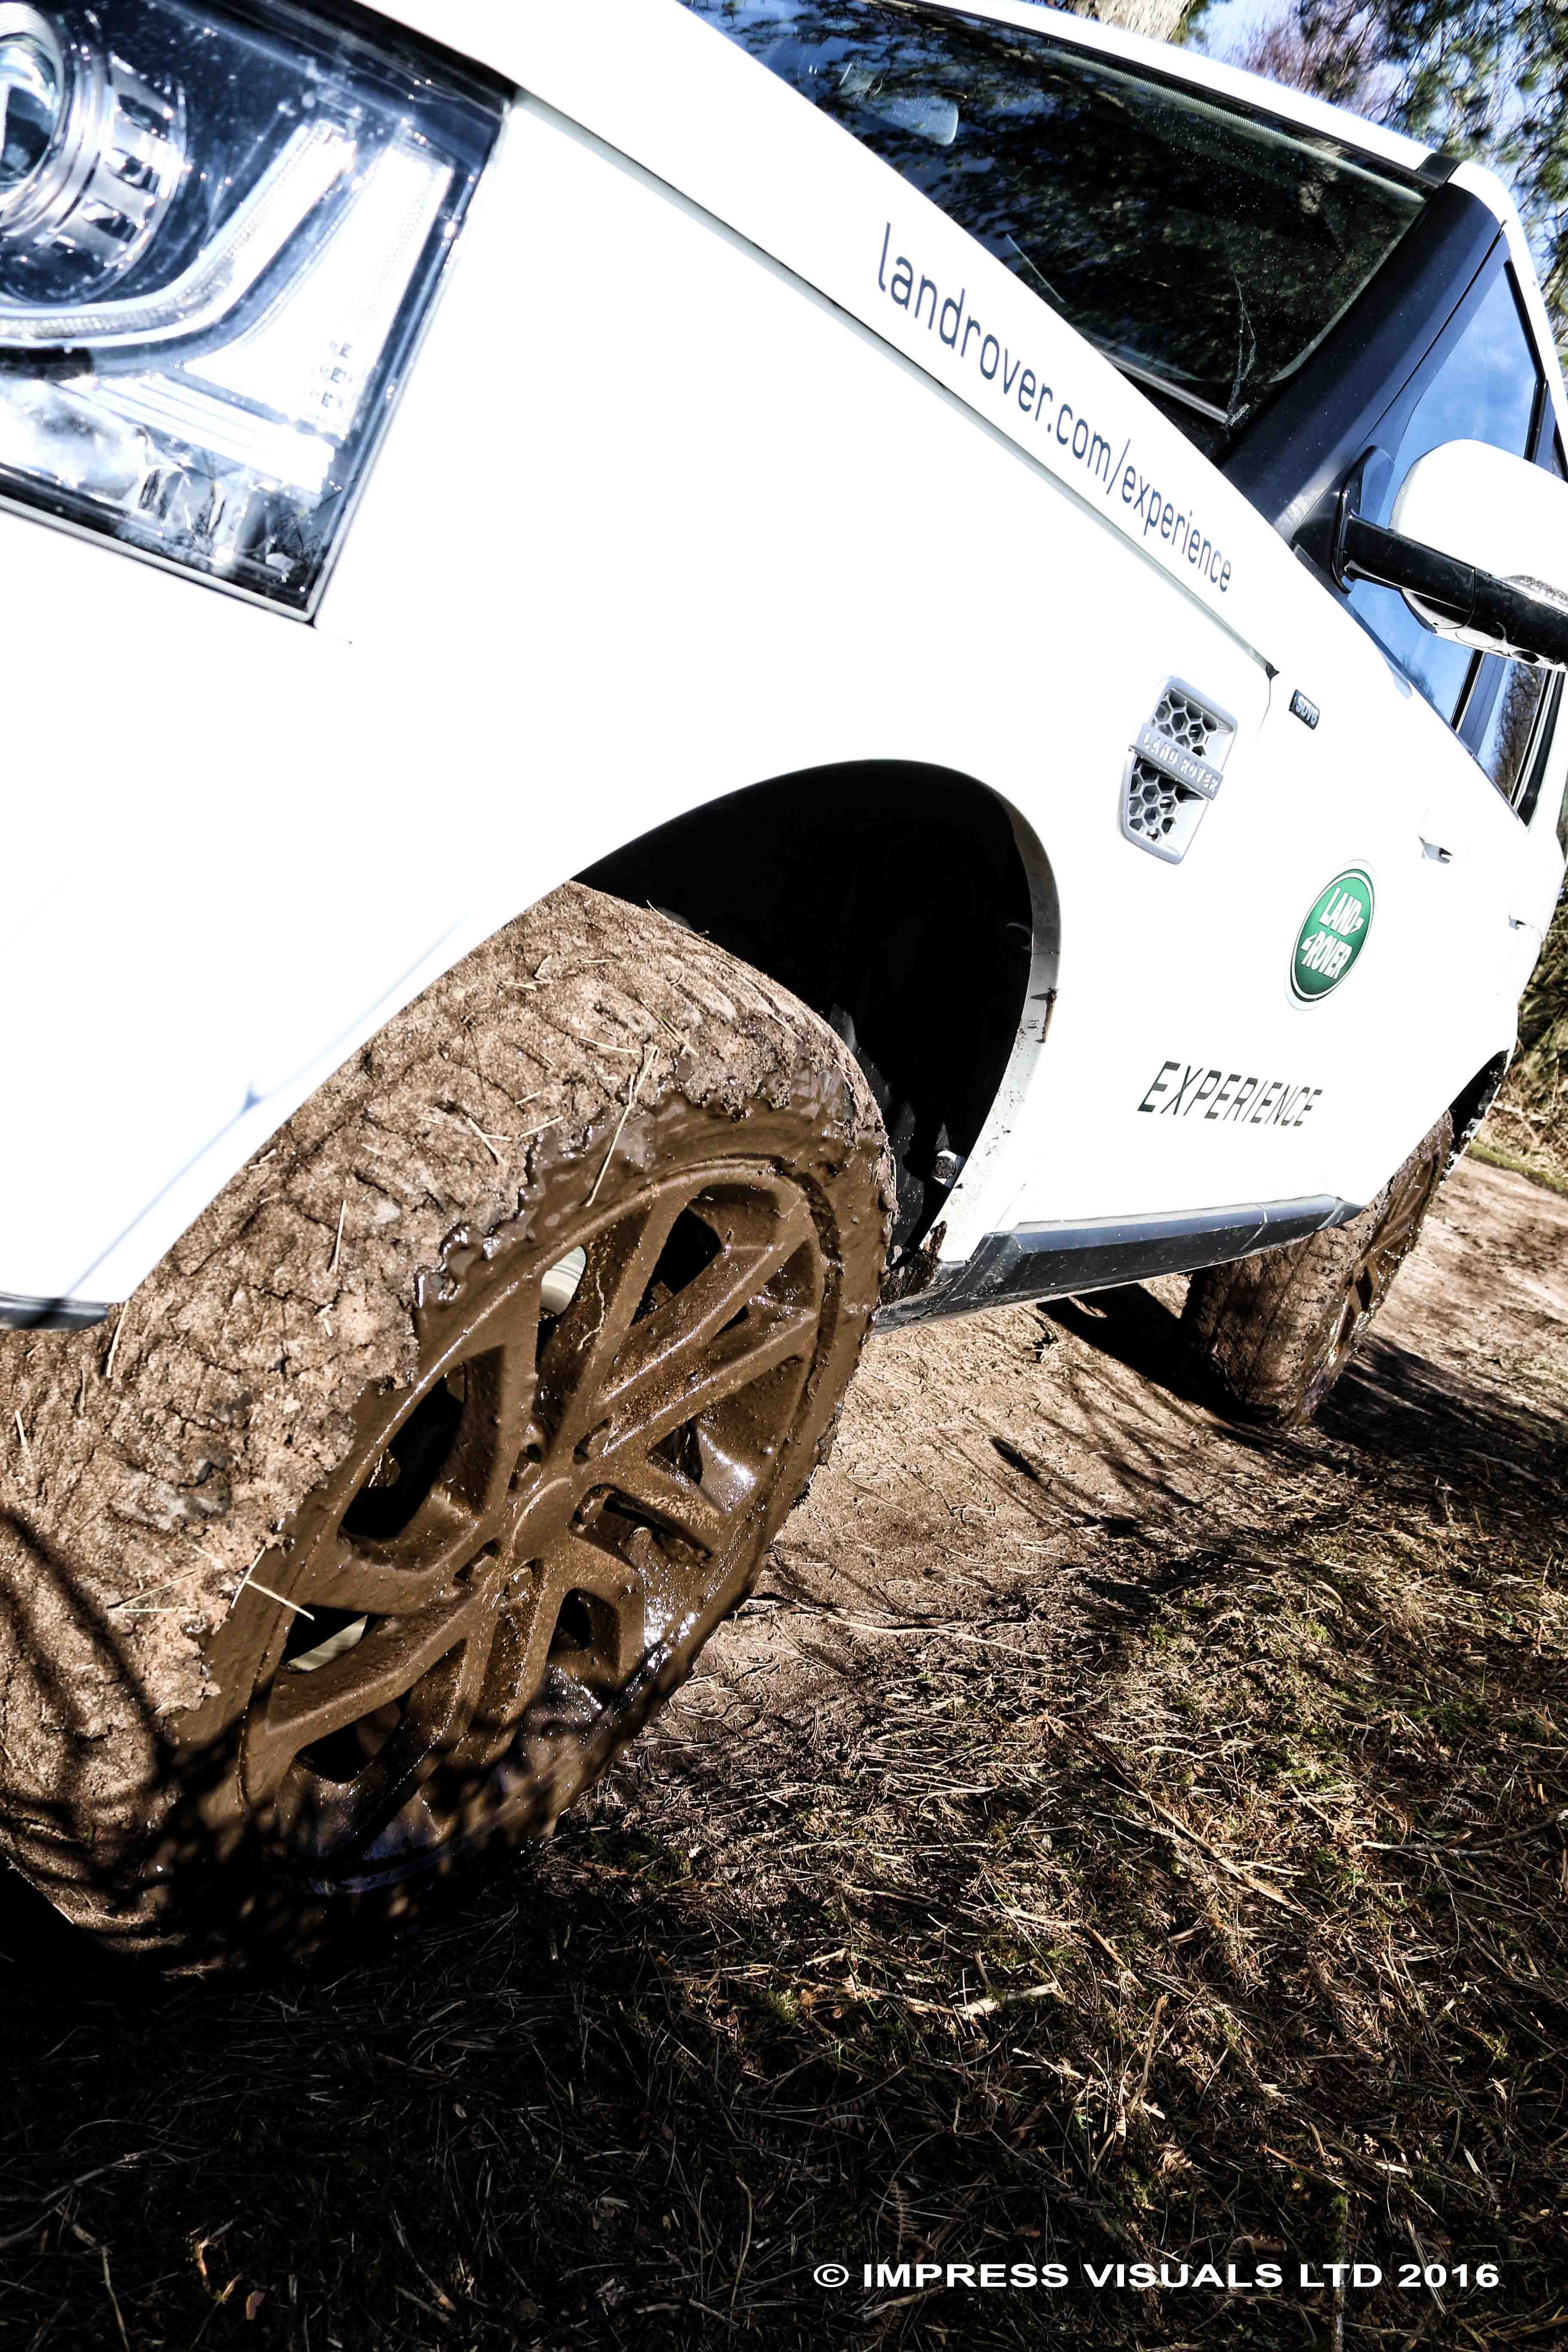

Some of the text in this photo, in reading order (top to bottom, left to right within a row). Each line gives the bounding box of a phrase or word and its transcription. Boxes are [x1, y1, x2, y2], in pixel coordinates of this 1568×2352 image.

[878, 221, 1232, 593] landrover.com/experience
[1295, 695, 1319, 726] SDV6
[1143, 732, 1219, 793] LAND ROVER
[1319, 886, 1363, 937] LAND
[1300, 930, 1353, 980] ROVER
[1136, 1060, 1323, 1127] EXPERIENCE
